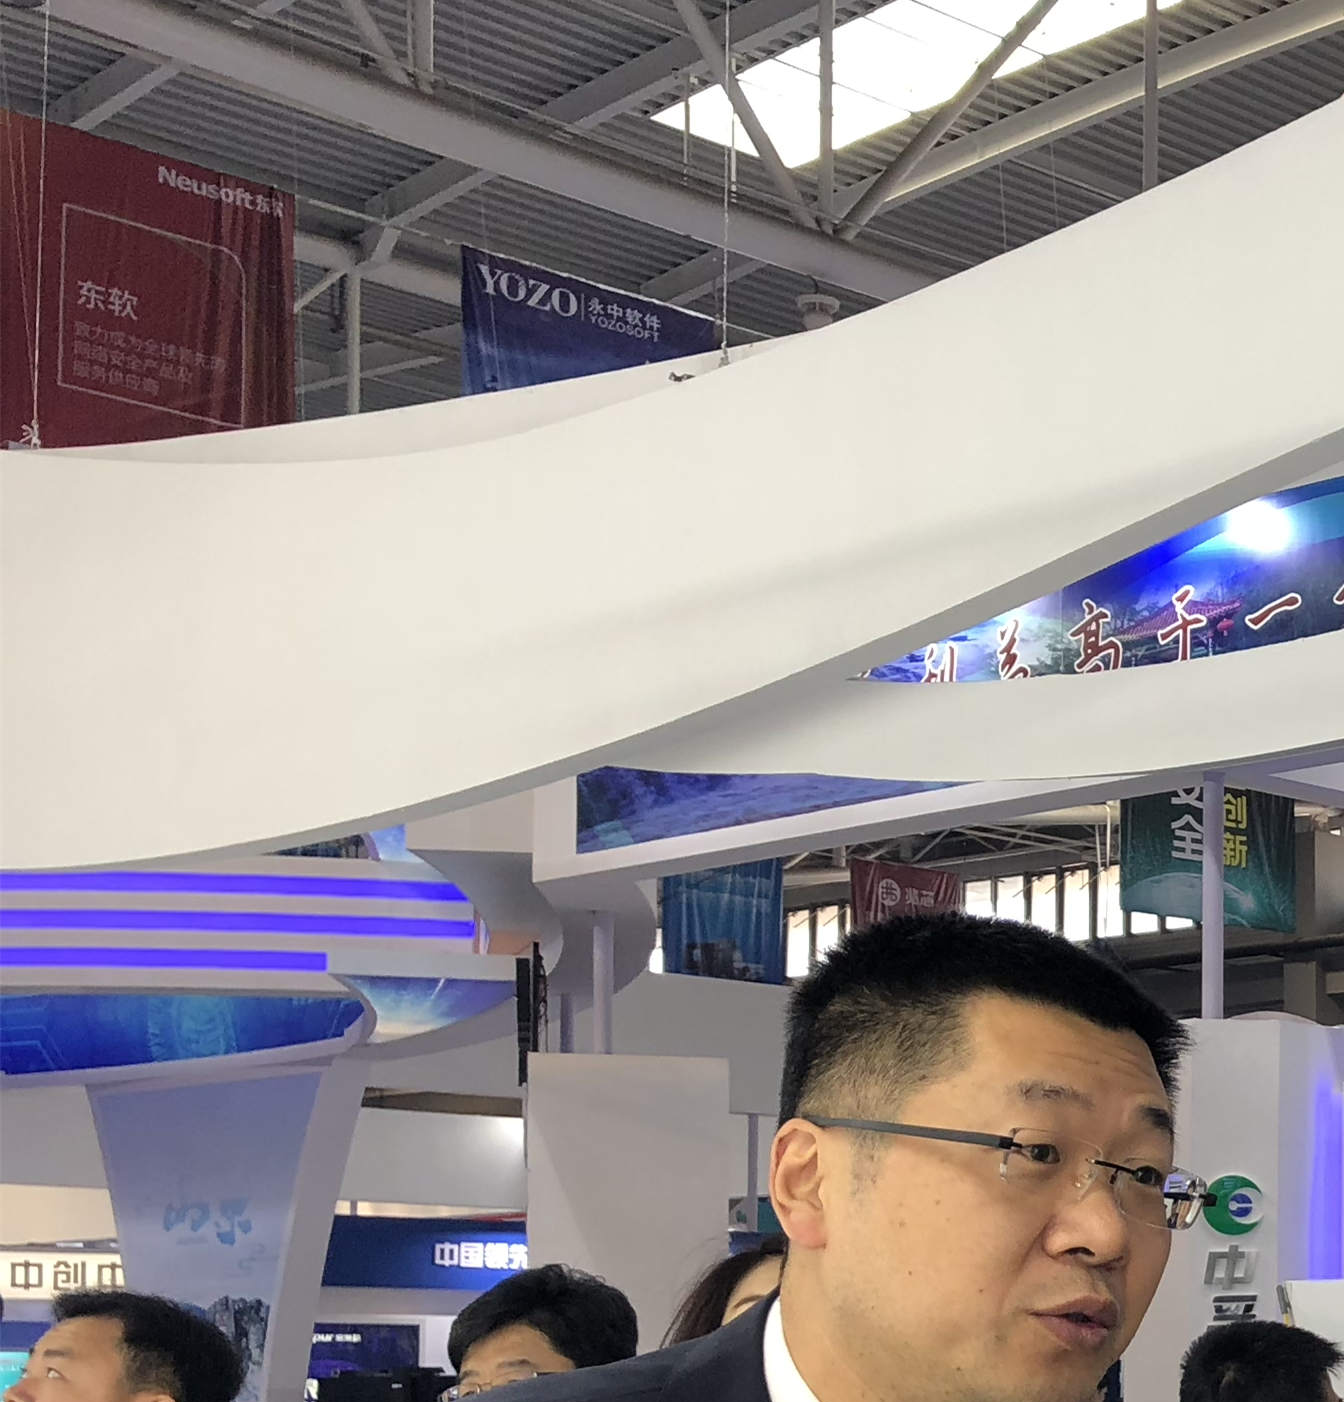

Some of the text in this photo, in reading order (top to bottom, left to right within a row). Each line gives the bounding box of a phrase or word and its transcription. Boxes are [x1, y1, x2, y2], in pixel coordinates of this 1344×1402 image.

[158, 165, 253, 209] Neusoft
[77, 280, 138, 321] 东软
[477, 263, 662, 330] YOZO 永中软件
[590, 314, 660, 342] YOZOSOFT
[1224, 793, 1248, 868] 创新
